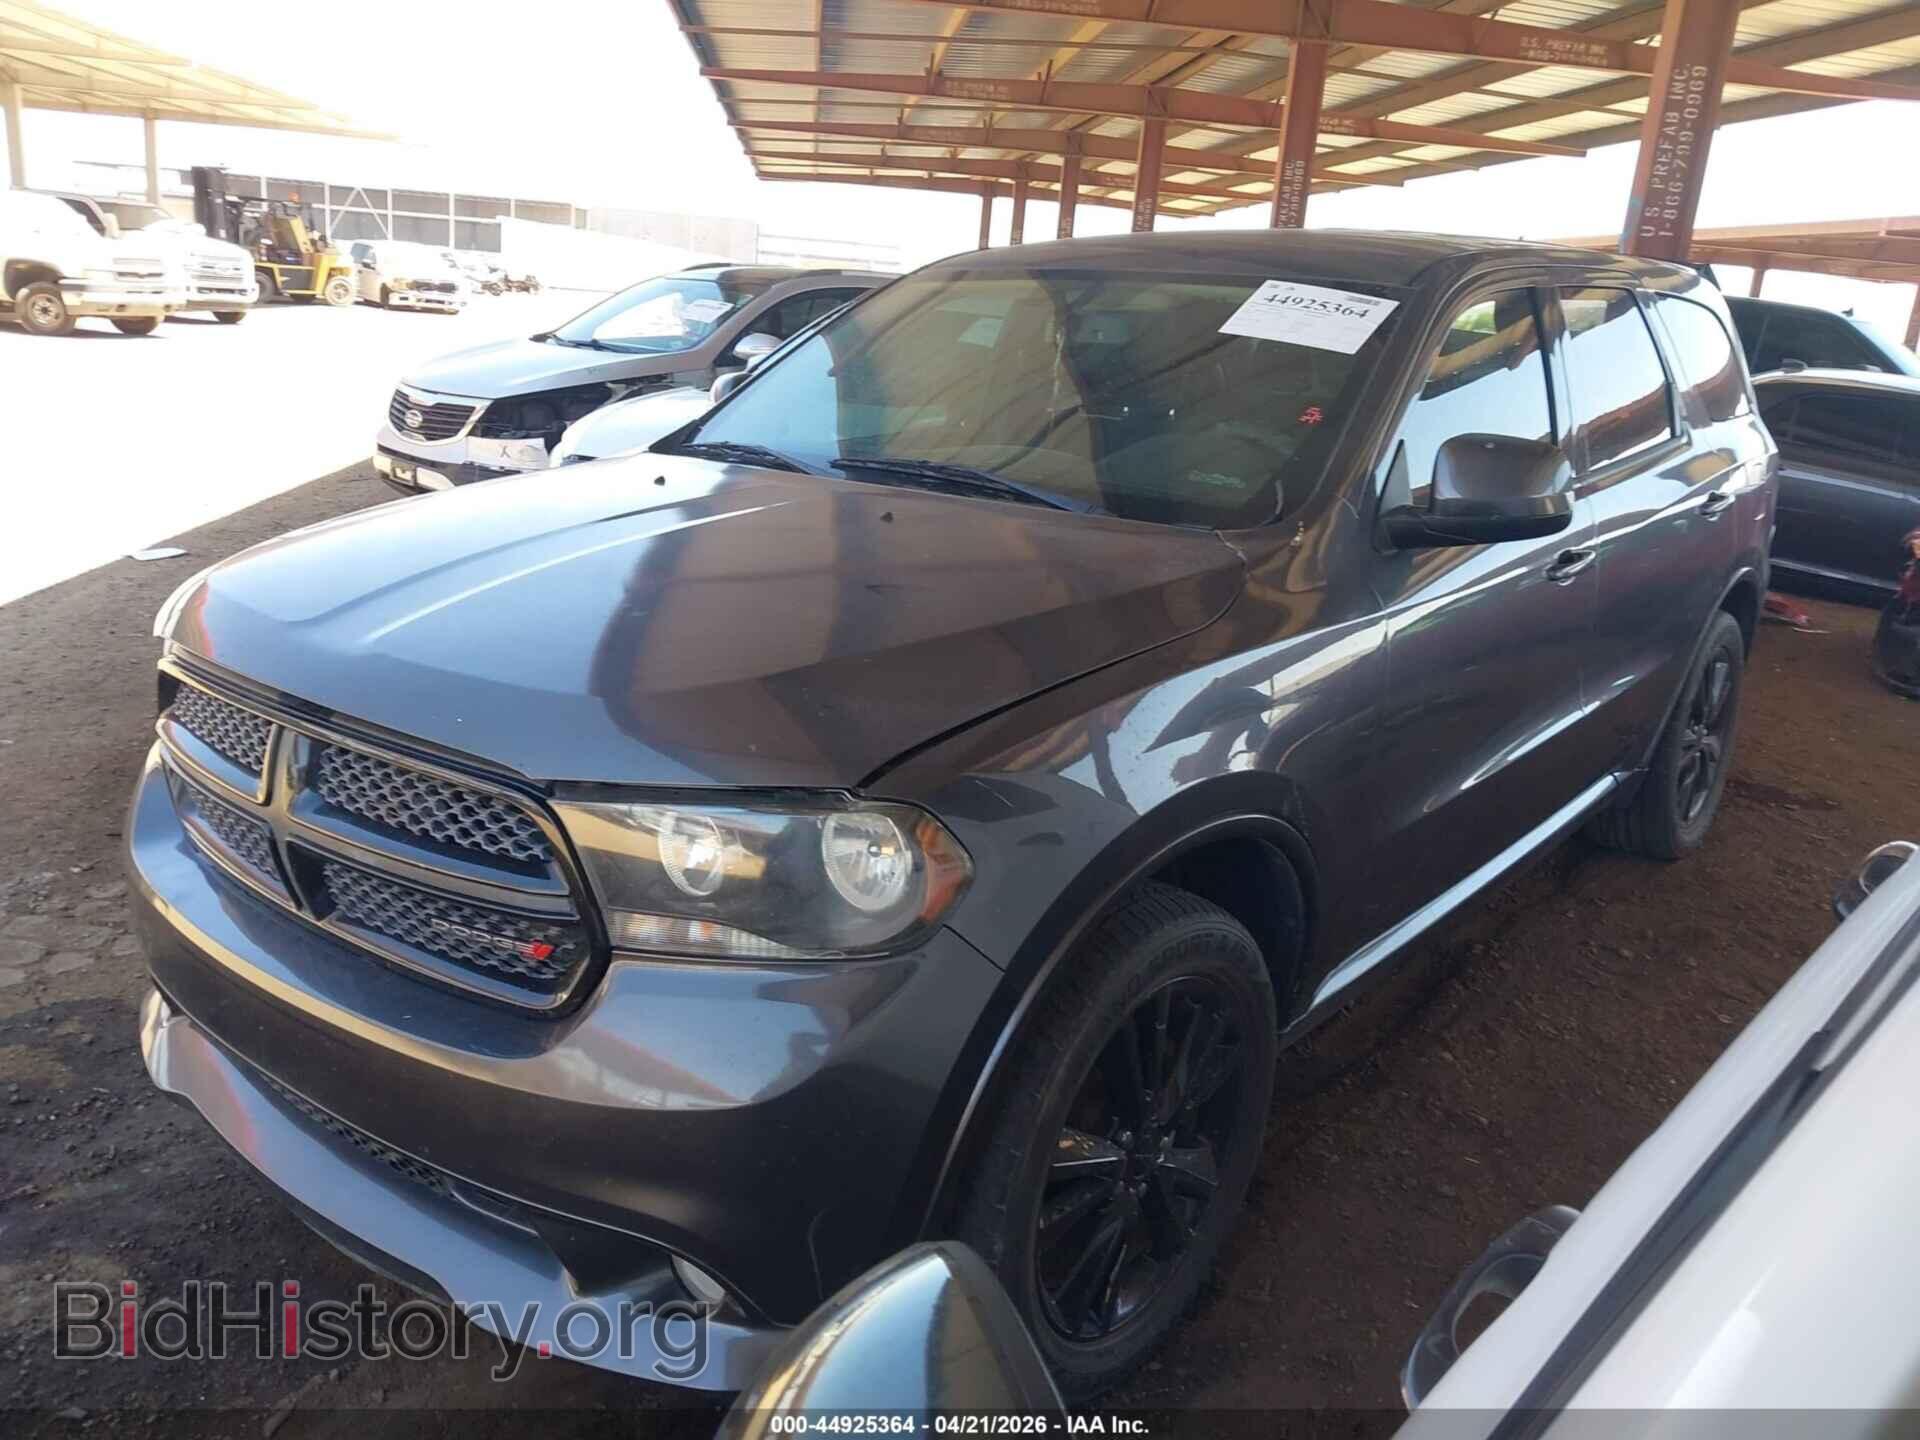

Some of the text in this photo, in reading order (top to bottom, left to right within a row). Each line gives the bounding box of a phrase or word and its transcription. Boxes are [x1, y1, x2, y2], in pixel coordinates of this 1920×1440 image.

[1651, 112, 1680, 189] PREFAB
[1658, 66, 1708, 236] 1-866-799-0969
[1264, 294, 1370, 319] 44925364
[430, 918, 535, 955] DODGE
